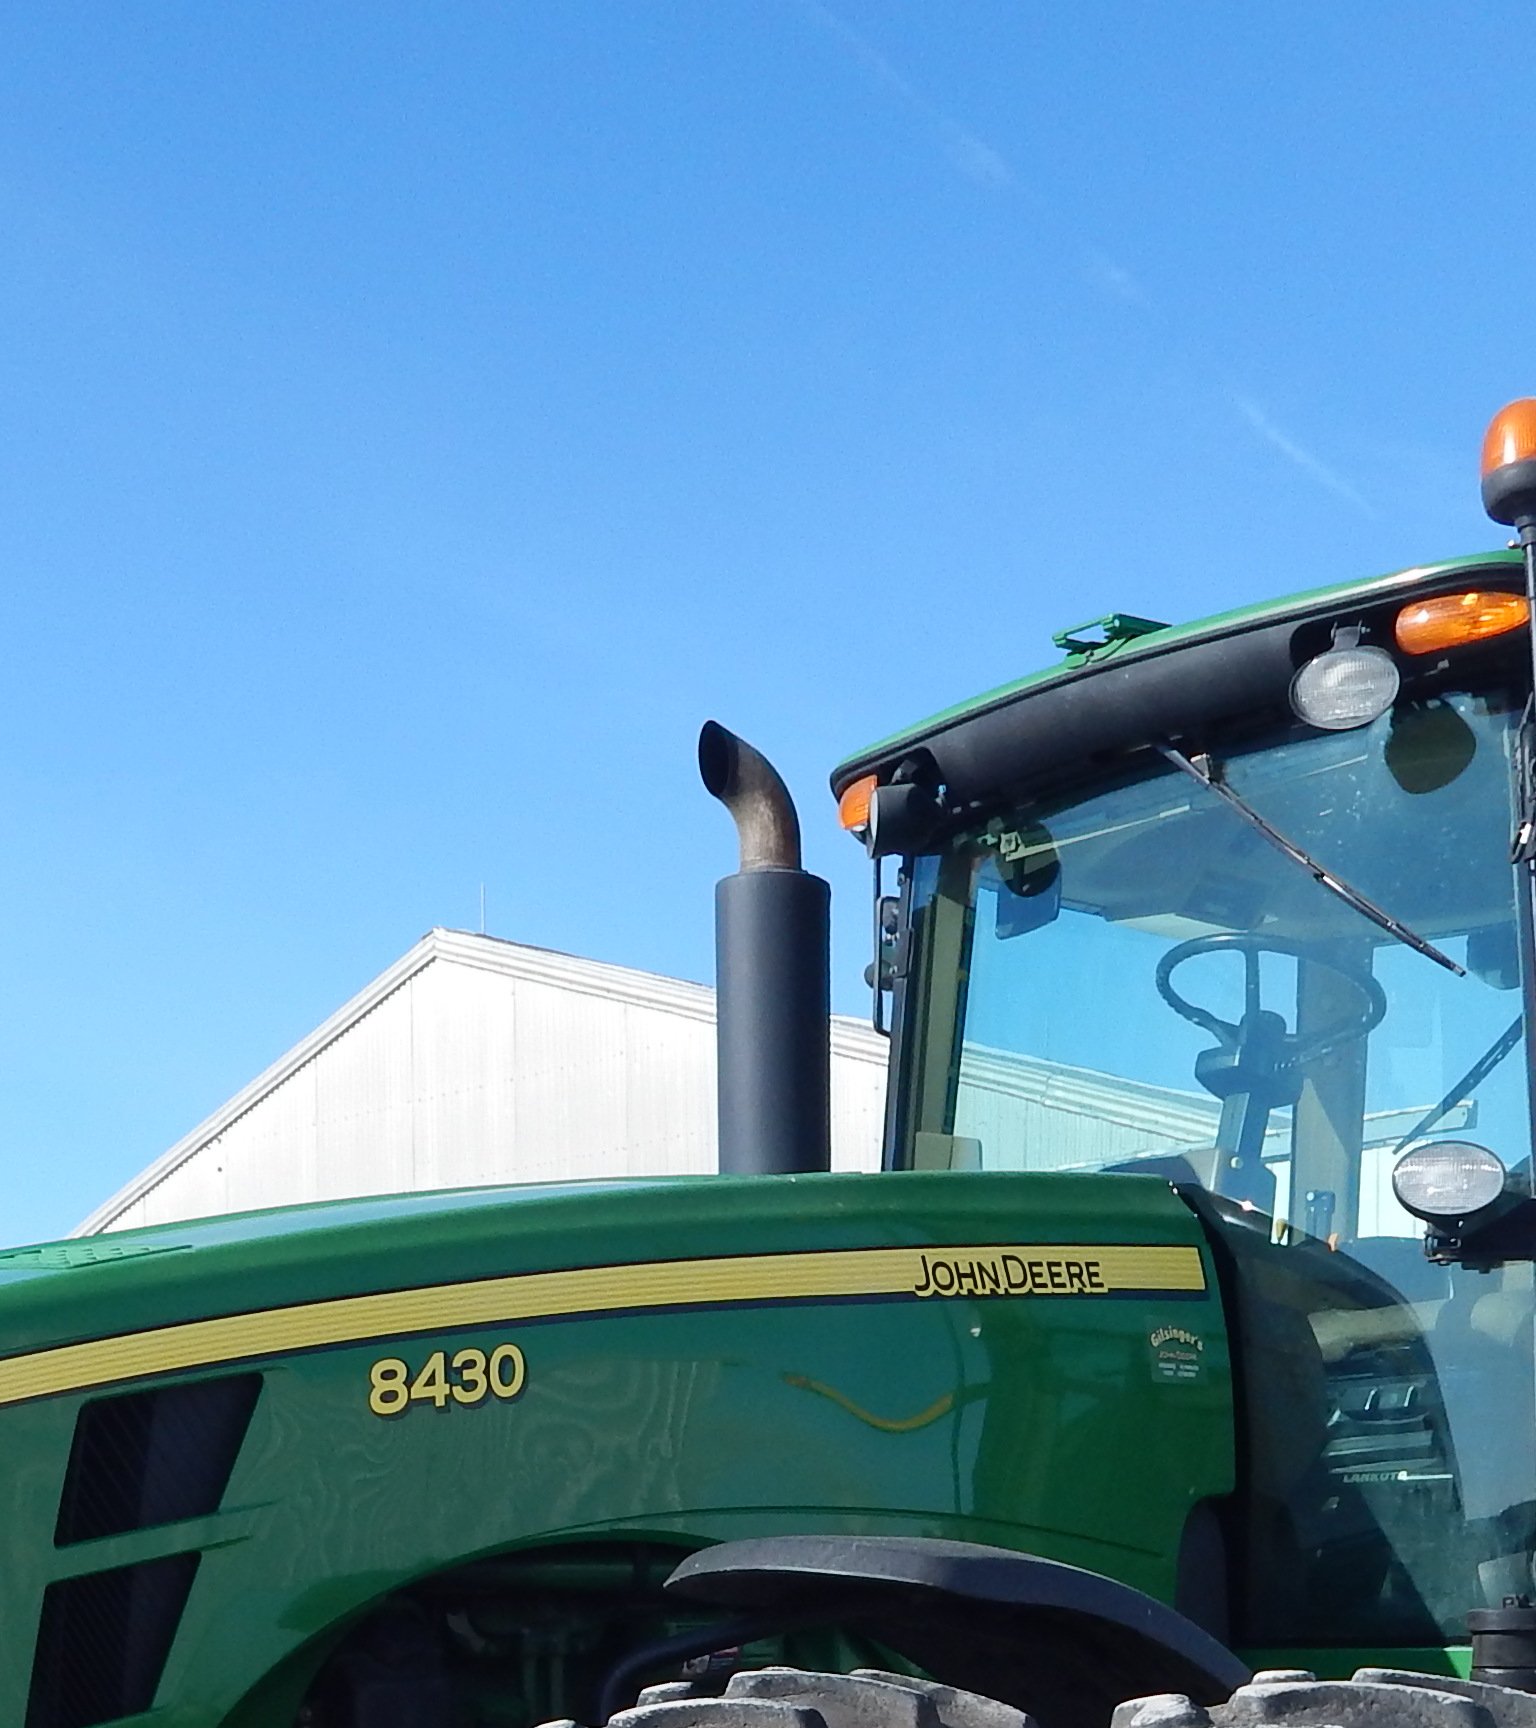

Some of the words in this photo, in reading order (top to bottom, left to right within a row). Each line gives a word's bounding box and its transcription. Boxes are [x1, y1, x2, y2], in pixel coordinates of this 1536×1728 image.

[915, 1255, 1001, 1291] JOHN
[1002, 1255, 1105, 1290] DEERE
[369, 1343, 525, 1416] 8430
